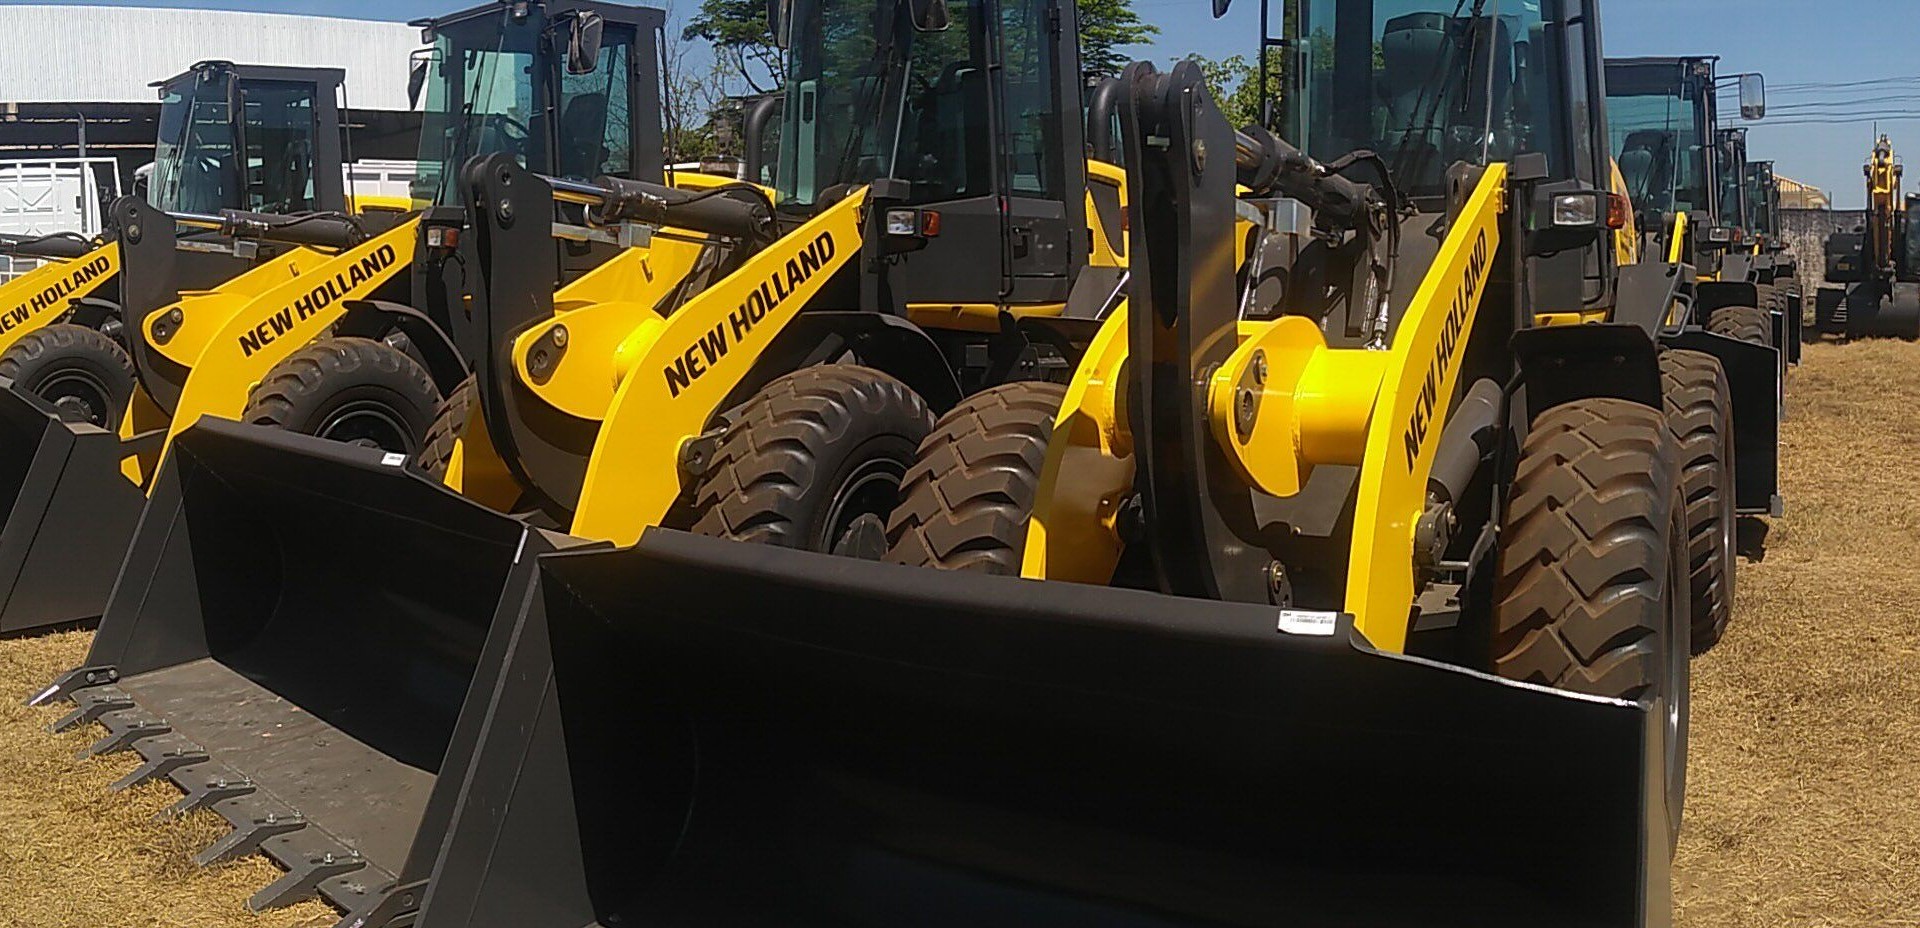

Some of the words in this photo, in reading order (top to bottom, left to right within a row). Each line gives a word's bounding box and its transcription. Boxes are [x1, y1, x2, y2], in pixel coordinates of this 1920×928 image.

[30, 255, 110, 313] HOLLAND
[238, 306, 294, 358] NEW
[294, 243, 396, 322] HOLLAND
[663, 321, 728, 399] NEW
[728, 231, 835, 344] HOLLAND
[1404, 358, 1436, 476] NEW
[1435, 226, 1487, 386] HOLLAND
